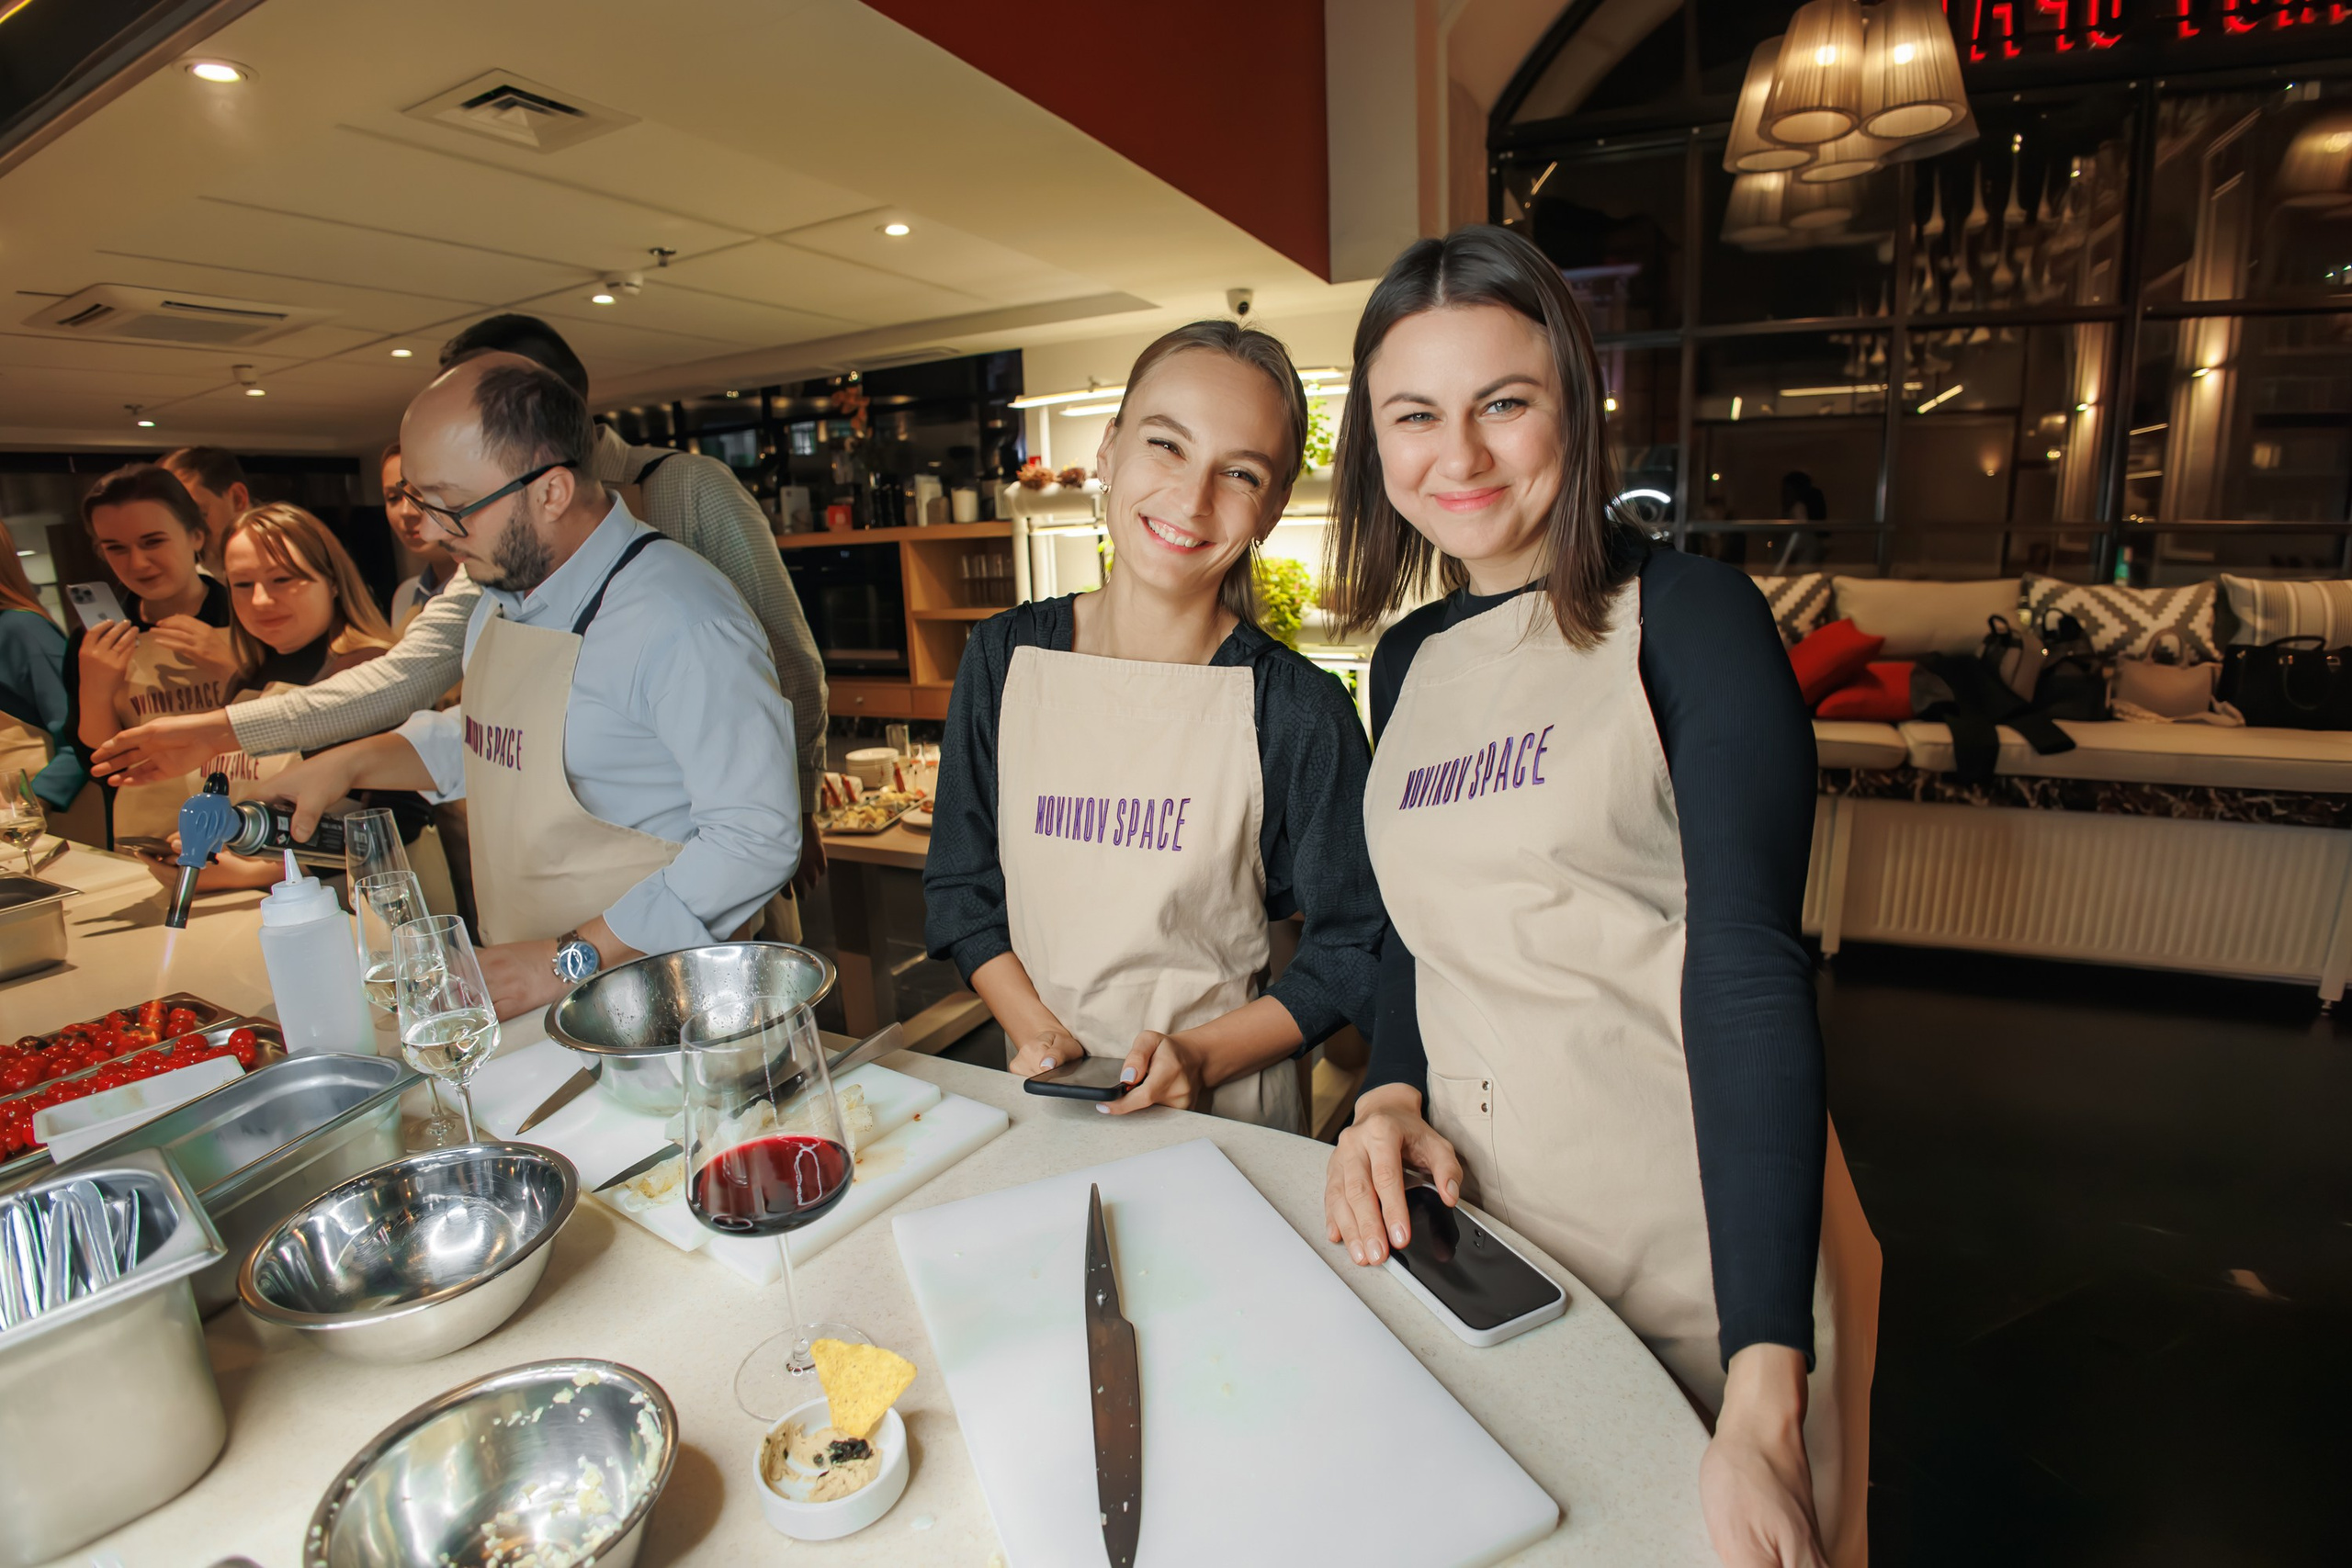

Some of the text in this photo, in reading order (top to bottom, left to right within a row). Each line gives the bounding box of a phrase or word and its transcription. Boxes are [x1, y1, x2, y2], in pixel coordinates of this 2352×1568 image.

[176, 681, 221, 713] SPACE
[486, 724, 524, 772] SPACE
[1398, 724, 1555, 810] NOVIKOV SPACE
[1035, 795, 1192, 852] NOVIKOV SPACE
